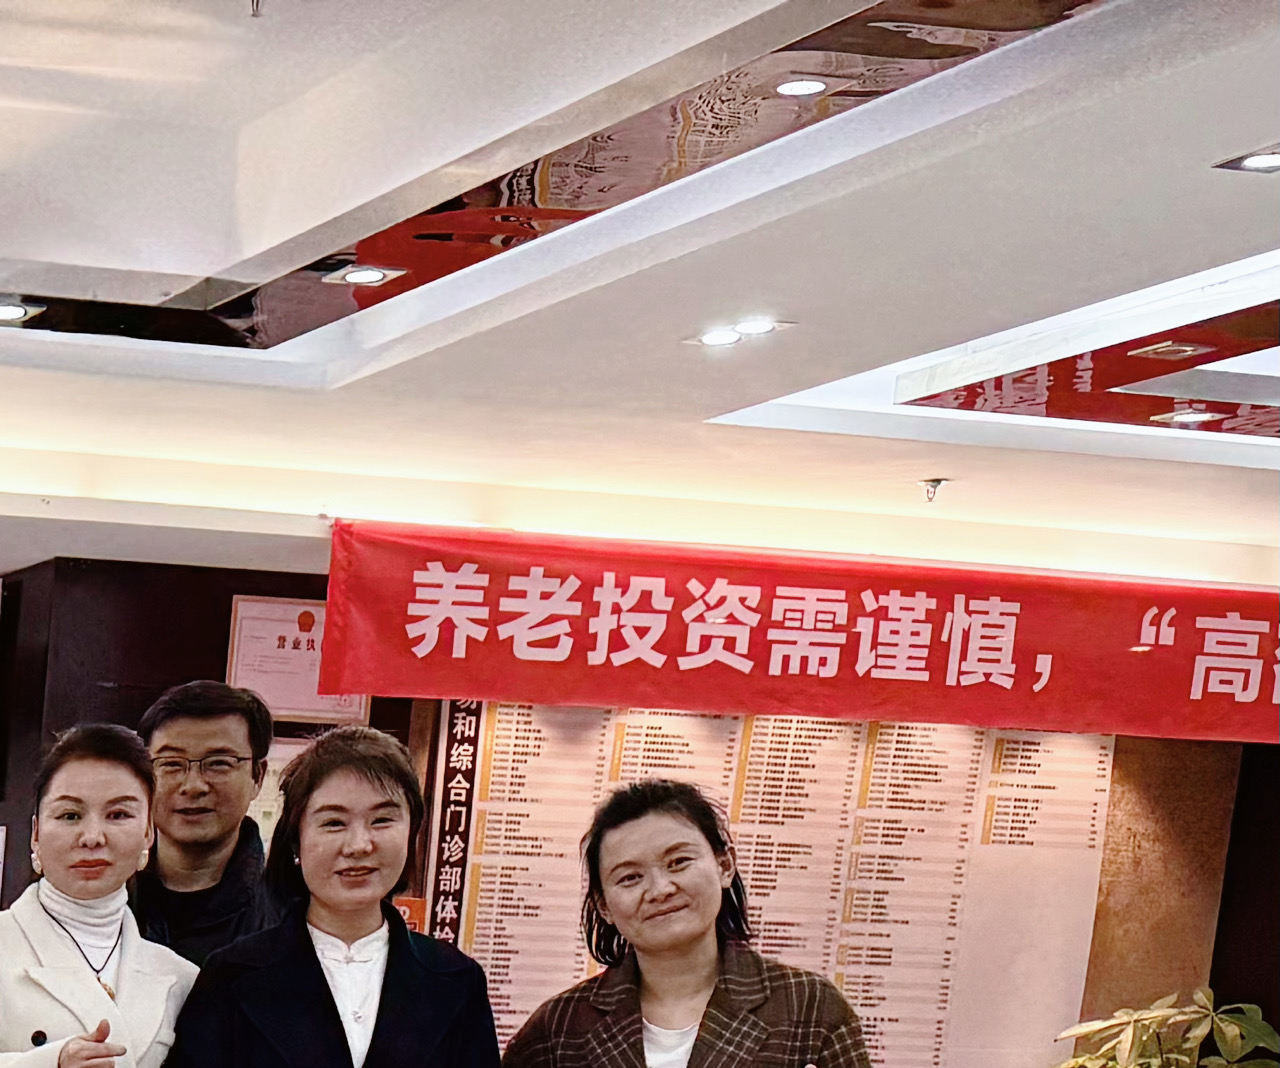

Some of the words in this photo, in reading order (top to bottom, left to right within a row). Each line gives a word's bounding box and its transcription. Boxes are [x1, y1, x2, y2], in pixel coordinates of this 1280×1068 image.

[276, 634, 317, 652] 营业执
[405, 561, 1280, 704] 养老投资需谨慎，“高
